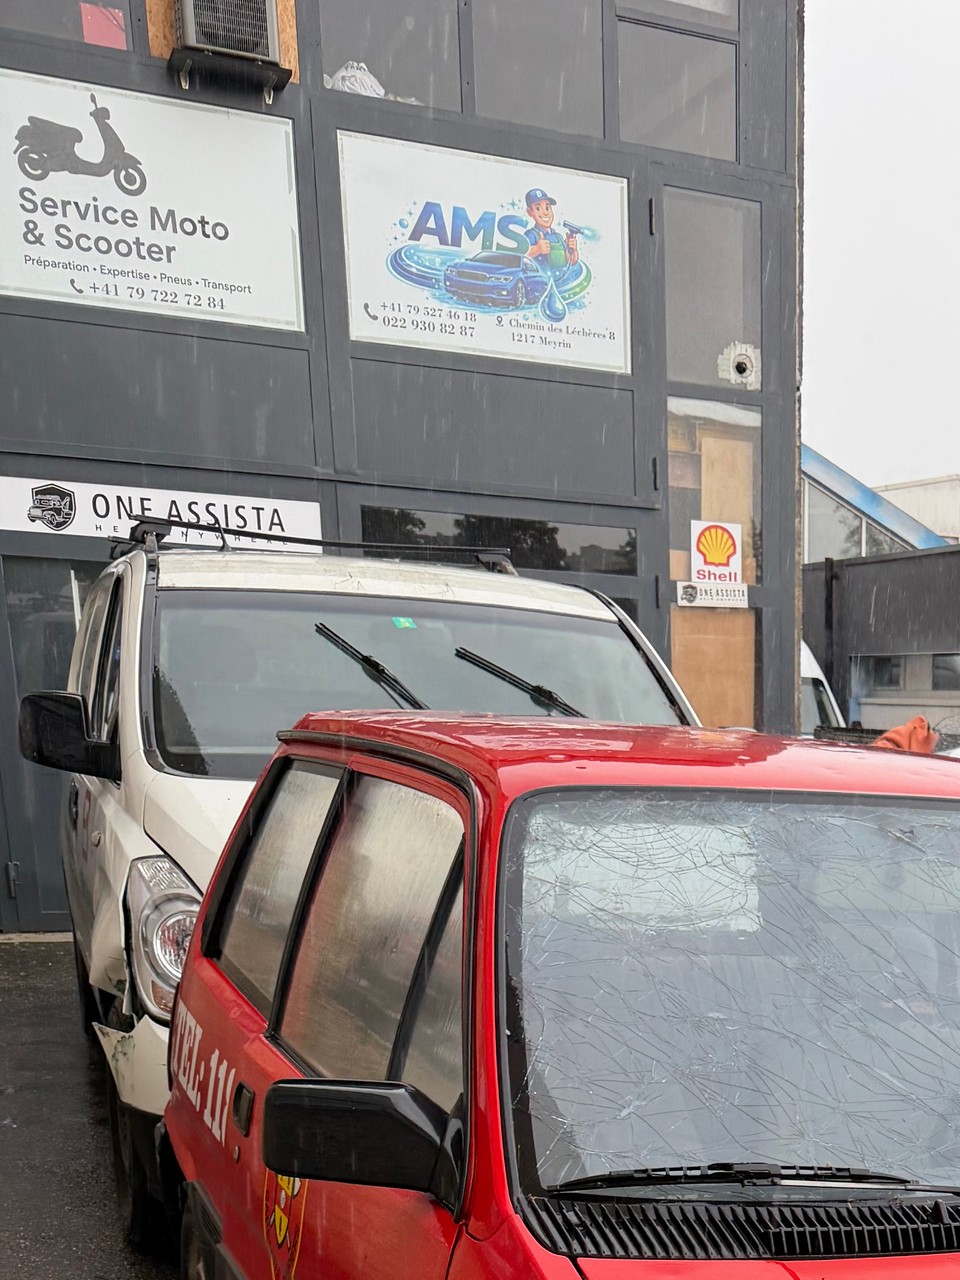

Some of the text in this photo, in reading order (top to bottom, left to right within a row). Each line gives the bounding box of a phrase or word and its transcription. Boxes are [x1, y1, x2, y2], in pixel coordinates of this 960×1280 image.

[18, 187, 230, 241] Service Moto
[22, 219, 177, 264] & Scooter
[408, 201, 531, 256] AMS
[24, 254, 252, 295] Préparation Expertise Pneus Transport
[89, 282, 226, 310] +41 79 722 72 84
[381, 302, 402, 313] +41
[407, 304, 420, 315] 79
[423, 306, 443, 318] 527
[464, 311, 477, 322] 18
[382, 315, 475, 338] 022 930 82 87
[509, 317, 545, 332] Chemin
[547, 323, 563, 334] des
[608, 331, 616, 341] 8
[511, 332, 571, 350] 1217 Meyrin
[167, 499, 286, 533] ASSISTA
[696, 569, 737, 582] Shell
[699, 588, 745, 598] ONE ASSISTA
